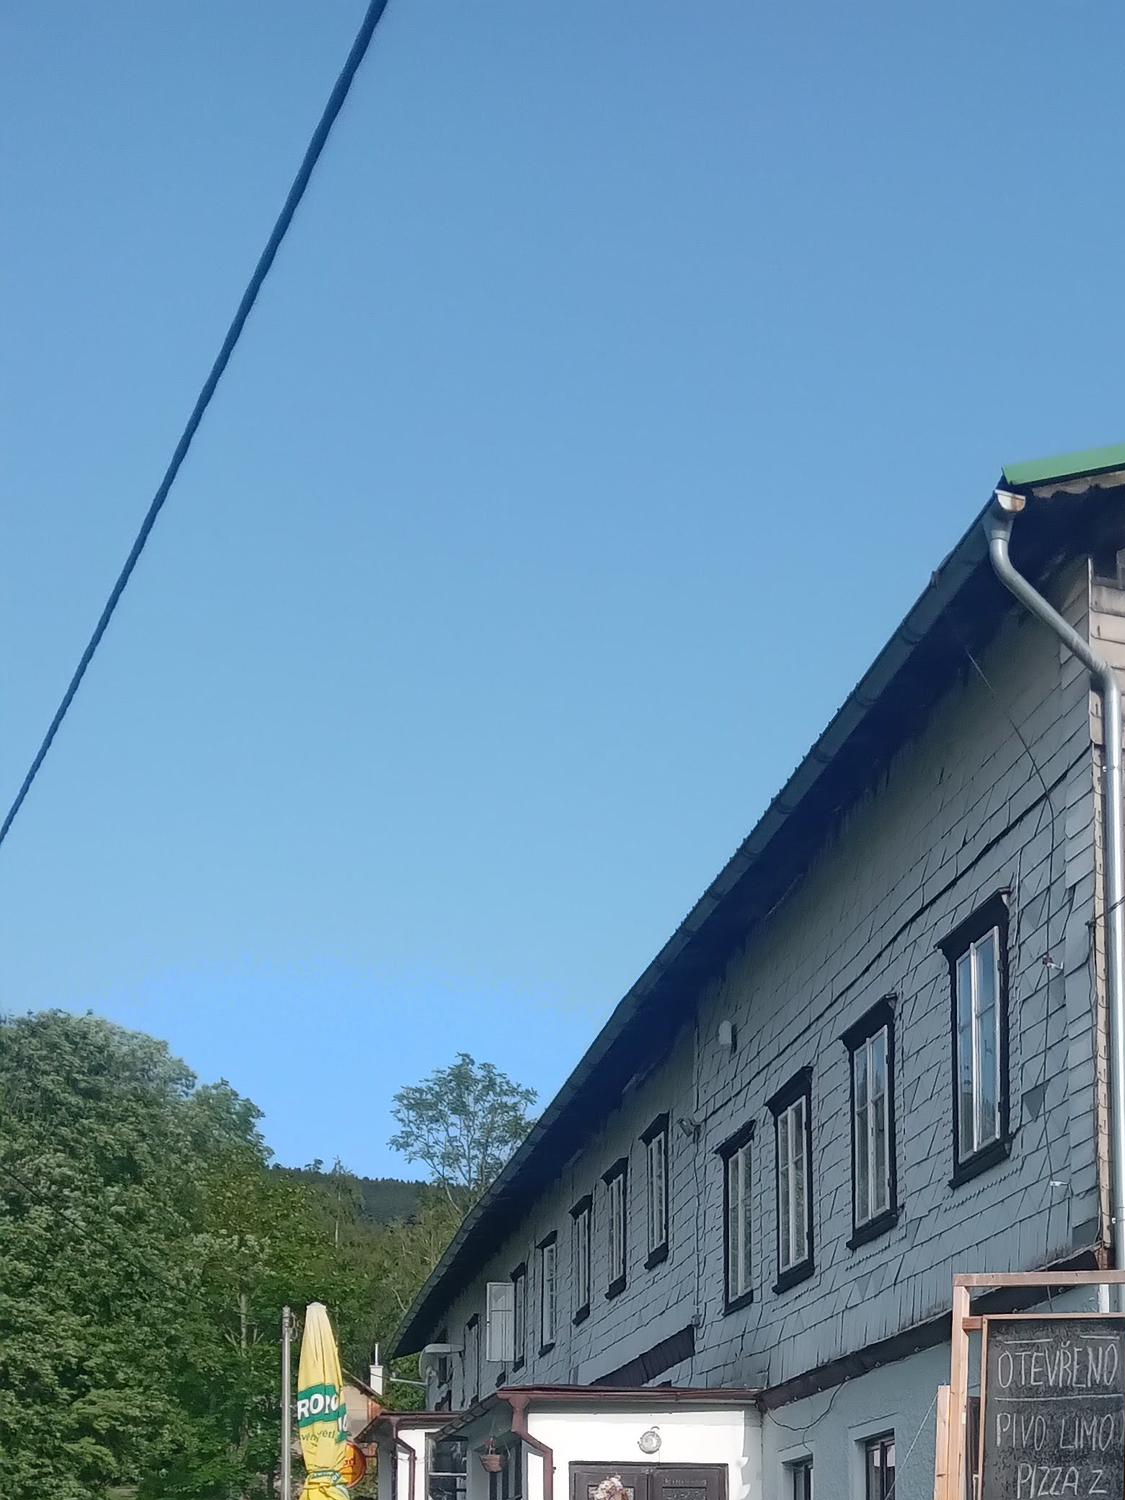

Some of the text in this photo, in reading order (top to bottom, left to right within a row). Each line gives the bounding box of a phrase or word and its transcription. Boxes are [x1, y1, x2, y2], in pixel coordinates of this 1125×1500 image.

[998, 1340, 1119, 1389] OTEVŘENO
[996, 1413, 1115, 1452] PIVO LIMO
[1017, 1463, 1079, 1499] PIZZA
